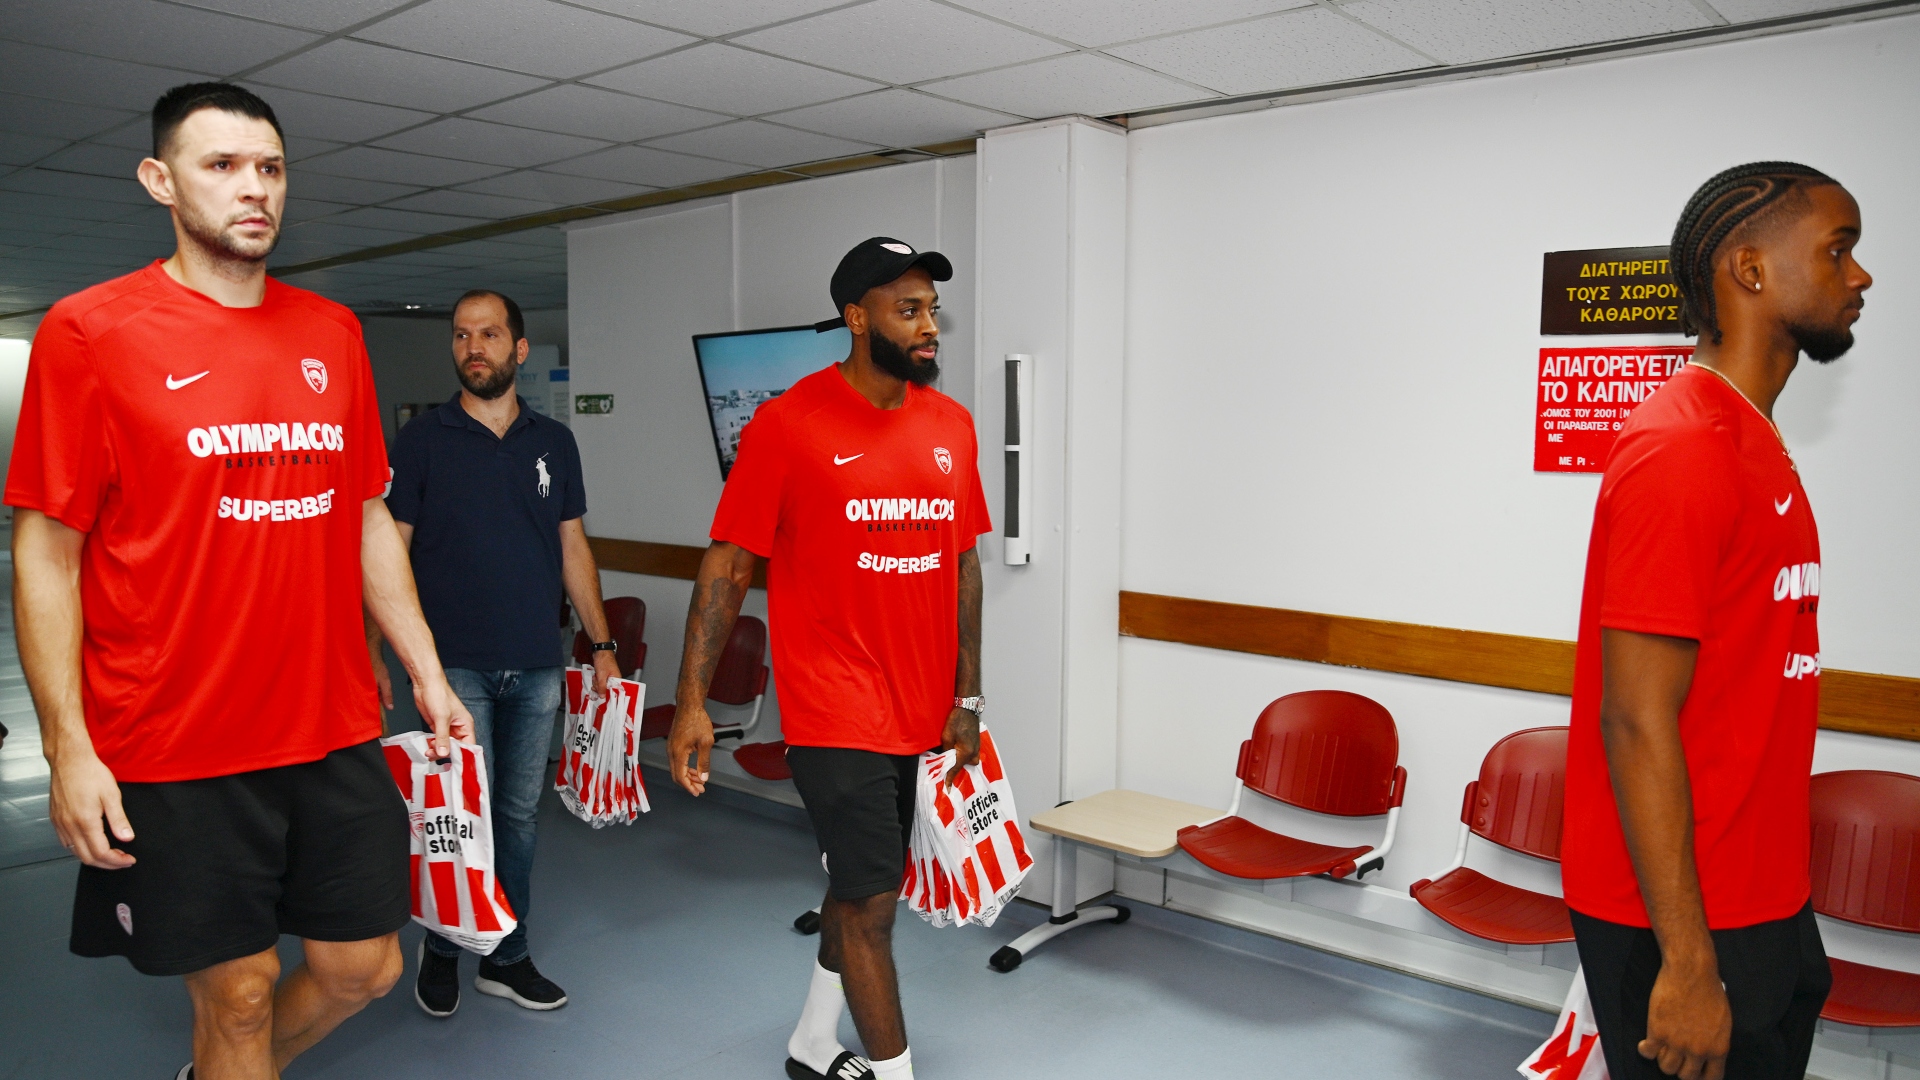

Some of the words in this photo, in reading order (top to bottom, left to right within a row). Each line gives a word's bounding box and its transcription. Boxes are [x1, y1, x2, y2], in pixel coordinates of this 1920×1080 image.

[1580, 259, 1671, 278] ΔΙΑΤΗΡΕΙΤ
[1566, 286, 1610, 302] ΤΟΥΣ
[1620, 284, 1683, 300] ΧΩΡΟΥ
[1581, 306, 1678, 322] ΚΑΘΑΡΟΥΣ
[1541, 381, 1568, 403] ΤΟ
[1577, 381, 1666, 403] ΚΑΠΝΙΣ
[1574, 408, 1591, 418] ΤΟΥ
[1594, 408, 1616, 418] 2001
[1543, 421, 1554, 430] ΟΙ
[1557, 421, 1609, 431] ΠΑΡΑΒΑΤΕΣ
[187, 422, 344, 458] OLYMPIACOS
[1548, 434, 1563, 443] ΜΕ
[226, 454, 329, 469] BASKETBALL
[845, 498, 955, 522] OLYMPIACOS
[857, 549, 941, 574] SUPERBE
[967, 790, 999, 820] officia
[425, 814, 474, 840] offial
[972, 808, 999, 835] store
